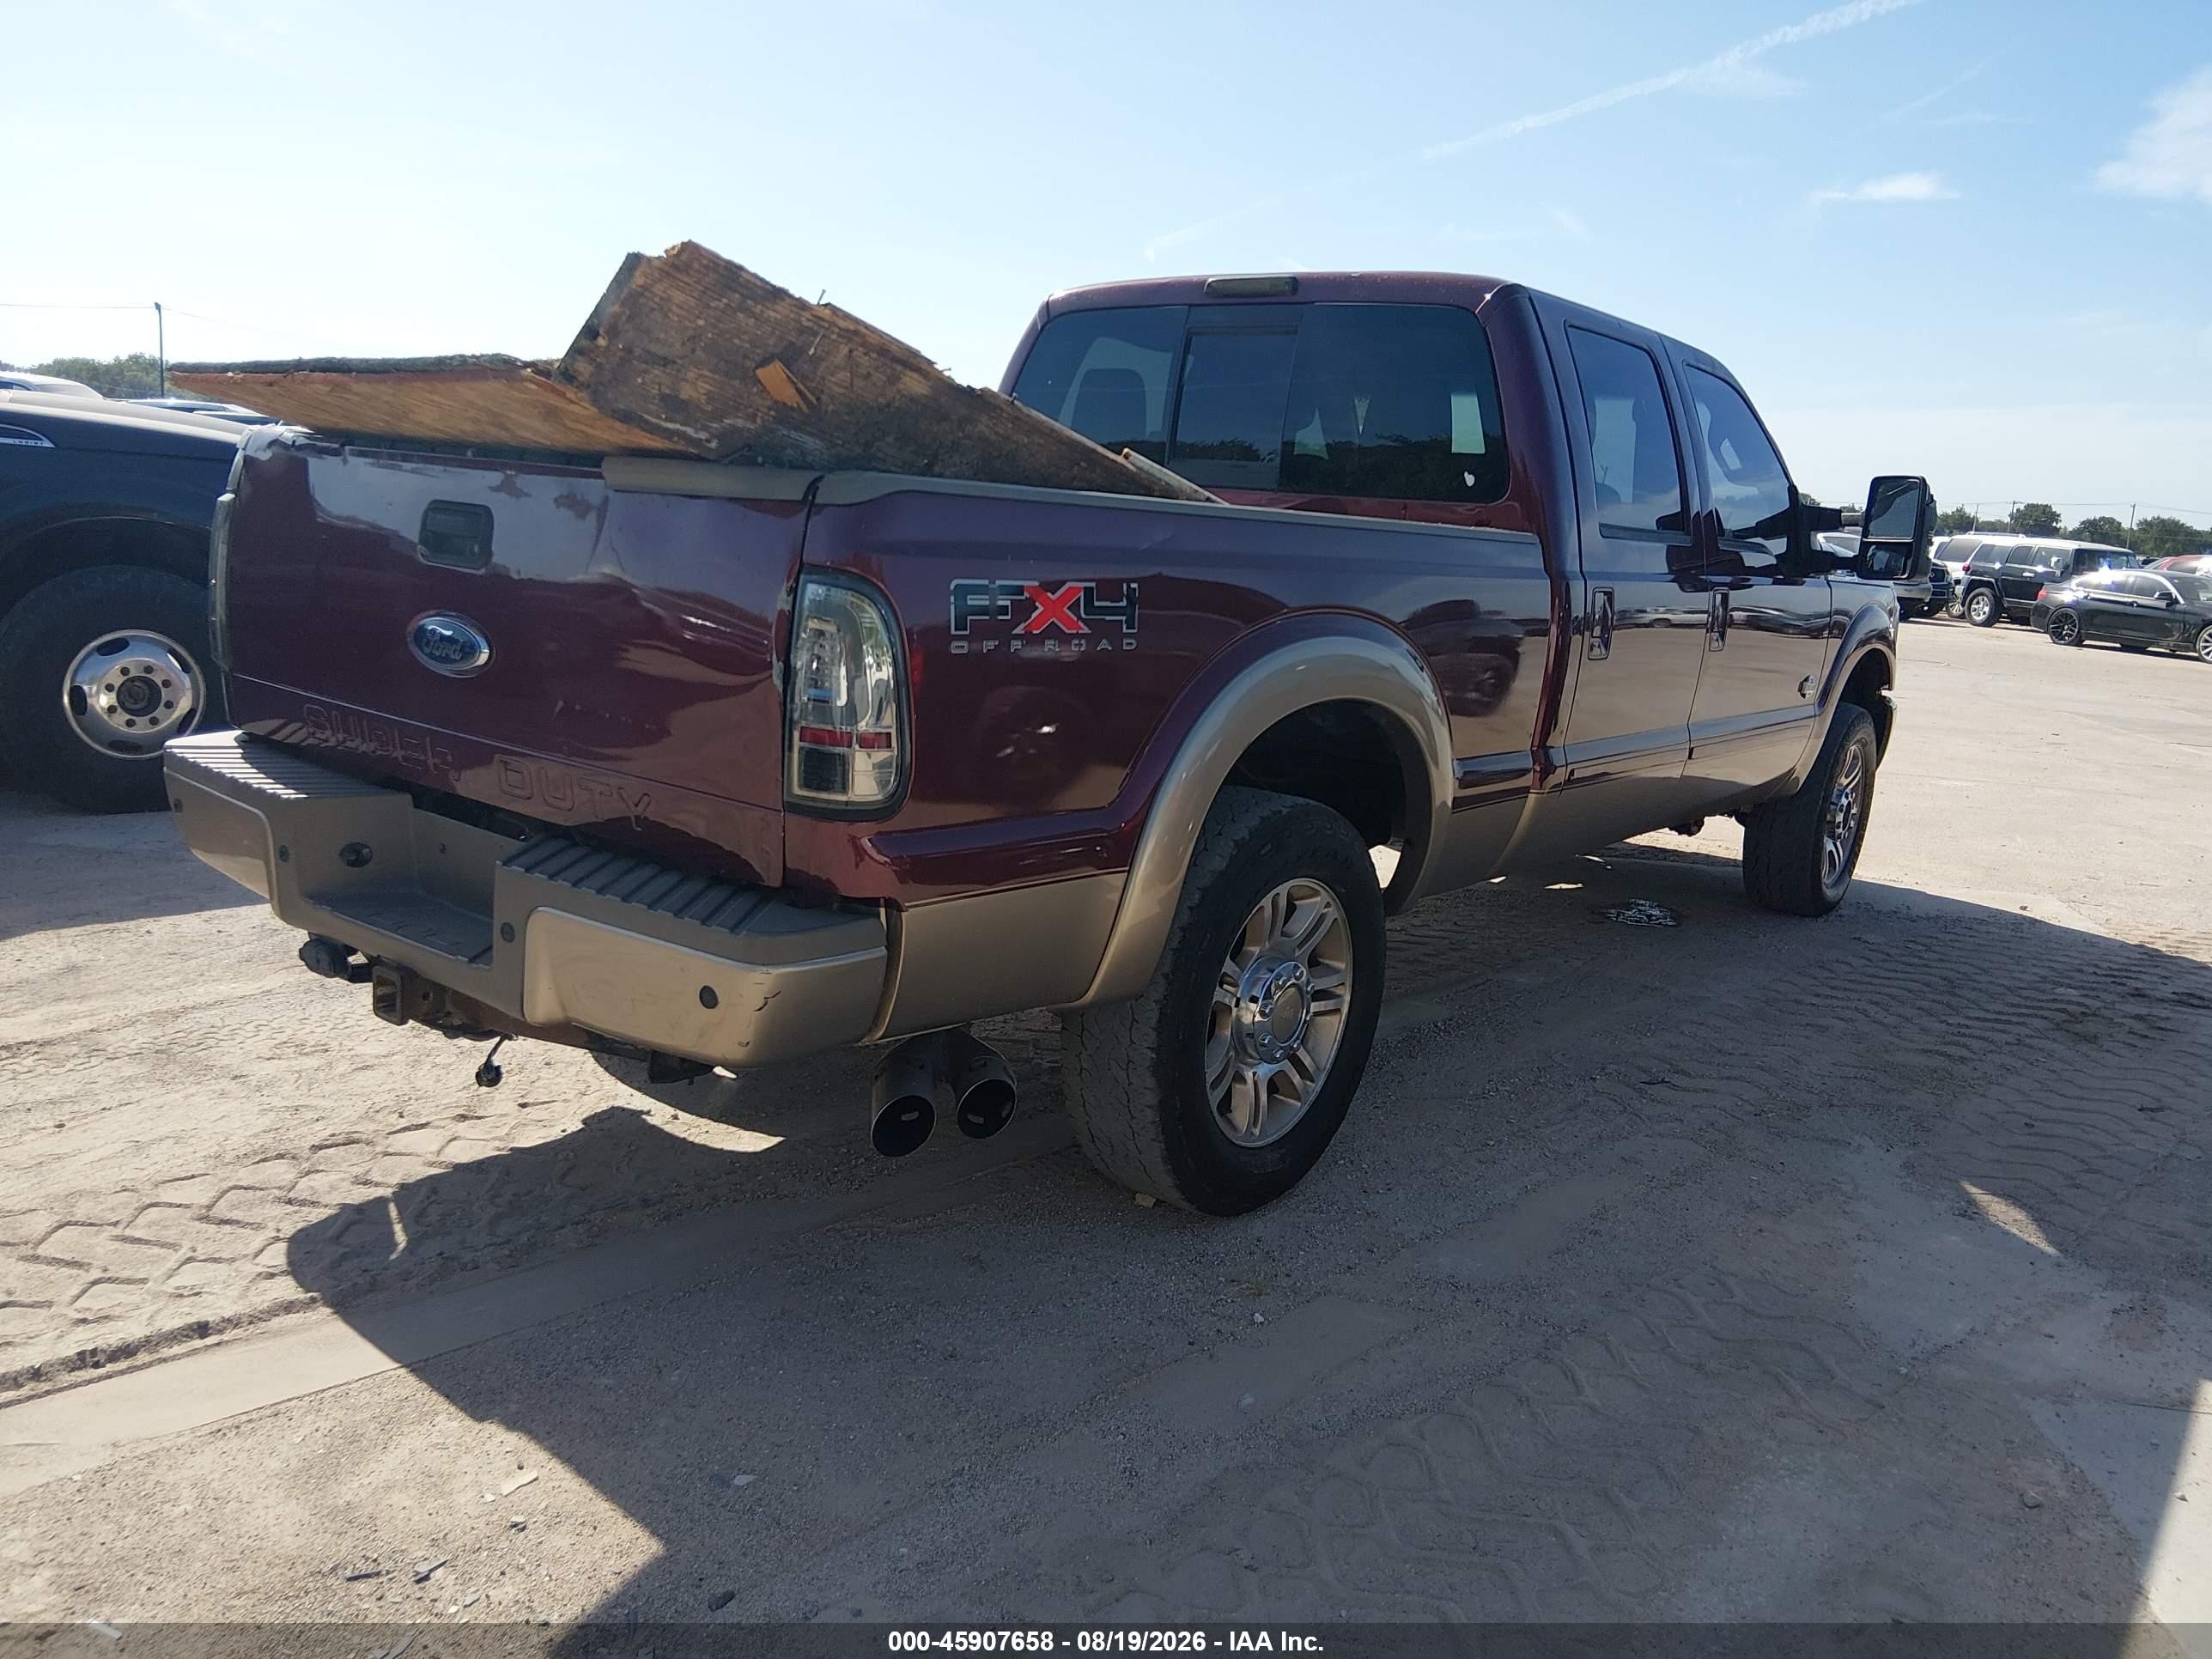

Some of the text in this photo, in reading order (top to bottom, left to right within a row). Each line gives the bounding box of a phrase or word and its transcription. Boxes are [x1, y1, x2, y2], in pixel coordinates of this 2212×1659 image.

[950, 579, 1139, 635] FX4
[951, 638, 1138, 654] OFF ROAD
[495, 753, 653, 831] DUTY
